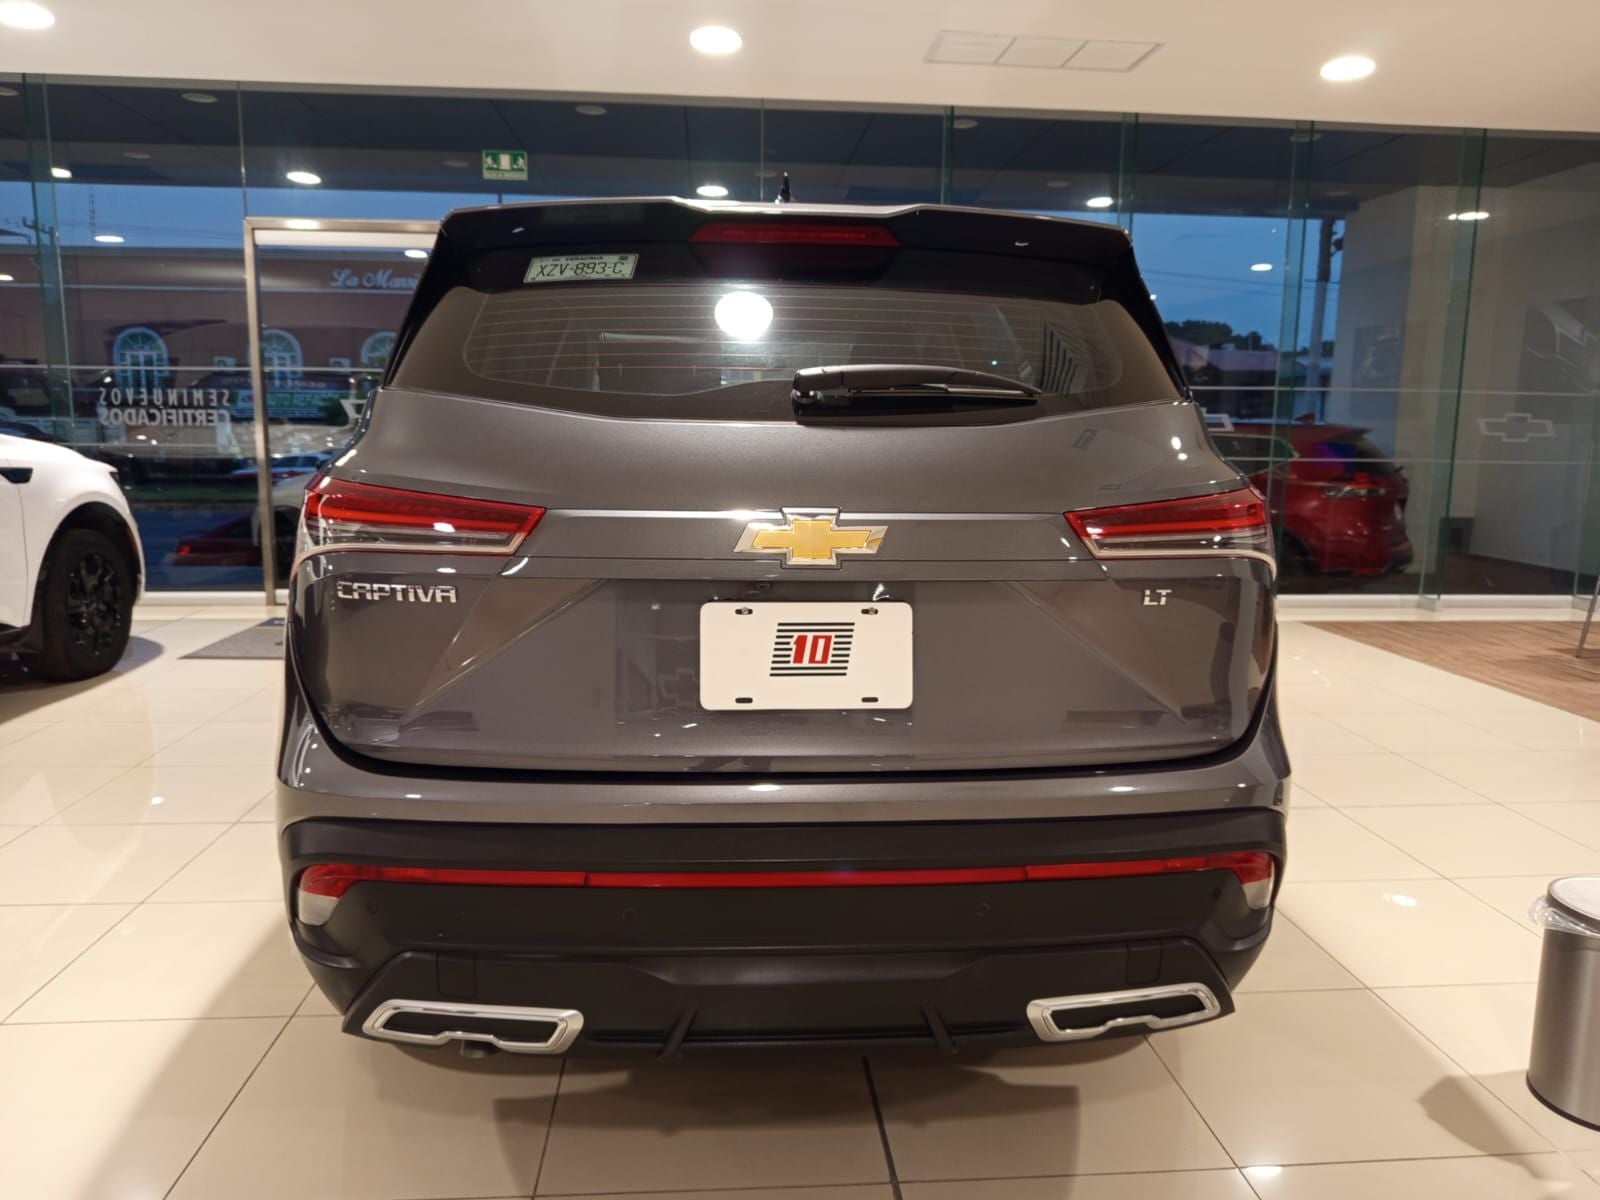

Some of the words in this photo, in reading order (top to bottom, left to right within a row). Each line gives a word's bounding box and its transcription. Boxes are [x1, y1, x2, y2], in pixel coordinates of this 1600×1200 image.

[536, 261, 625, 278] XZV-893-C
[337, 581, 457, 603] CAPTIVA
[1143, 589, 1172, 606] LT
[792, 634, 833, 664] 10
